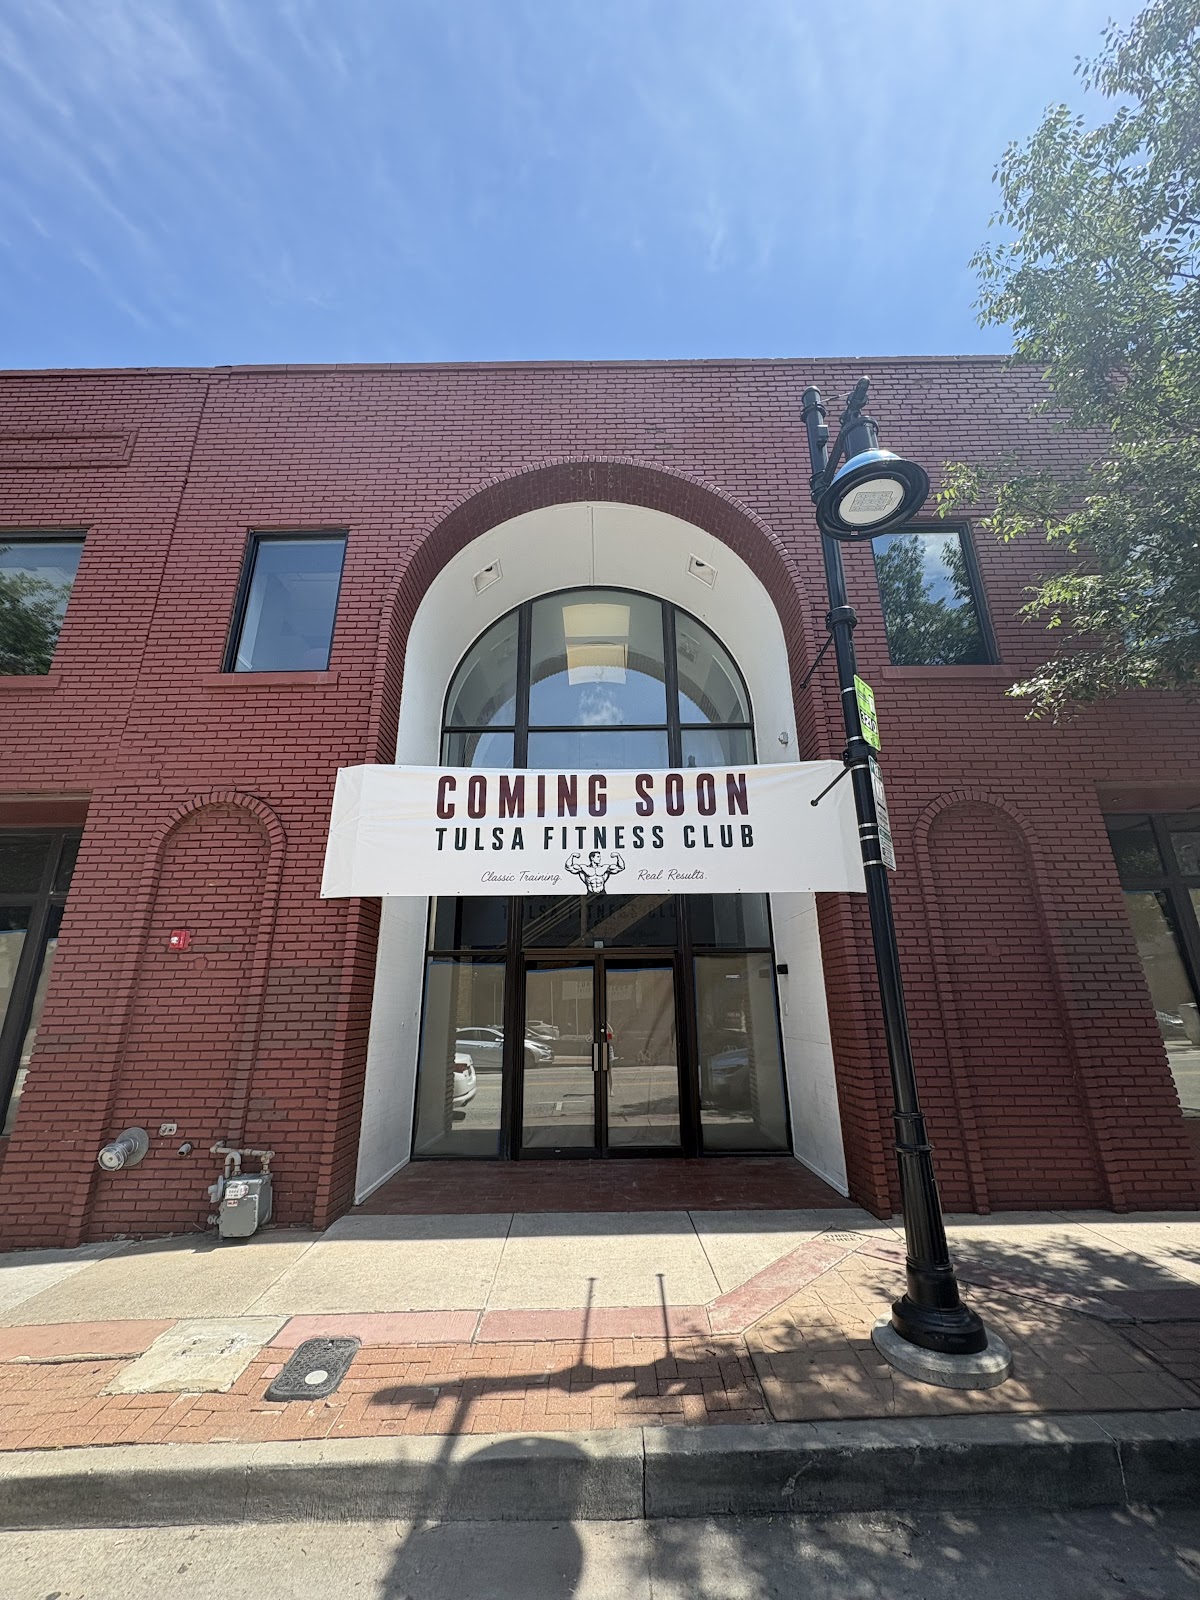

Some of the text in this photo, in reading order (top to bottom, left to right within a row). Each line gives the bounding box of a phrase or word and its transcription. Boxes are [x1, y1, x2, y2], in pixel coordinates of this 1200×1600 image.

[436, 772, 750, 820] COMING SOON
[435, 824, 754, 851] TULSA FITNESS CLUB
[480, 870, 563, 886] Classic Training.
[637, 868, 708, 881] Real Results.
